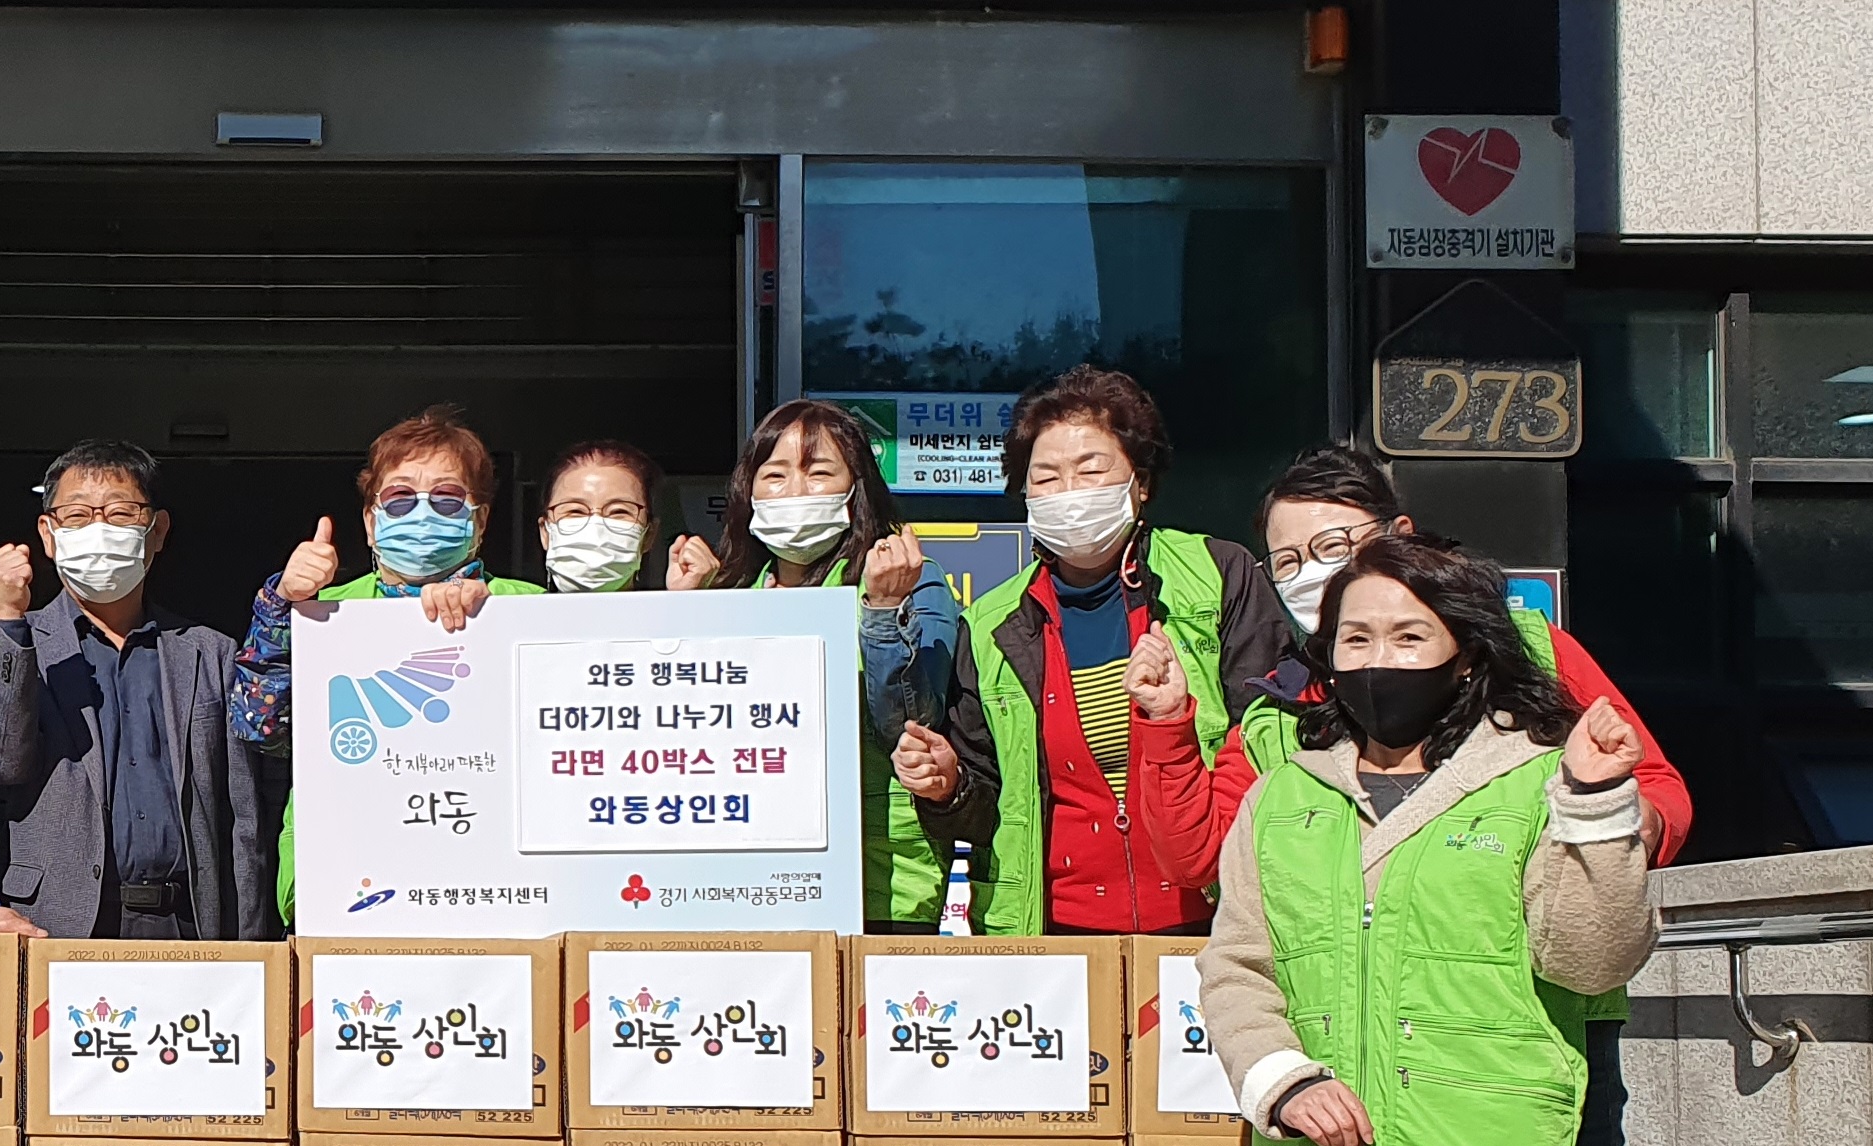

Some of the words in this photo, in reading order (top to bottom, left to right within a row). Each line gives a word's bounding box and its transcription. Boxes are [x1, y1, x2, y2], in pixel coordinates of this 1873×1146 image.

[1387, 227, 1491, 257] 자동심장충격기
[1495, 227, 1555, 257] 설치기관
[907, 402, 982, 427] 무더위
[1418, 369, 1571, 444] 273
[910, 433, 970, 450] 미세먼지
[933, 468, 963, 484] 031)
[587, 662, 635, 687] 와동
[650, 660, 749, 686] 행복나눔
[538, 705, 641, 731] 더하기와
[656, 703, 733, 729] 나누기
[749, 702, 801, 729] 행사
[382, 747, 401, 775] 한
[551, 749, 605, 776] 라면
[621, 748, 715, 775] 40박스
[732, 746, 787, 774] 전달
[402, 791, 478, 835] 와동
[588, 794, 750, 825] 와동상인회
[408, 887, 548, 905] 와동행정복지센터
[72, 1028, 137, 1072] 와동
[148, 1010, 239, 1064] 상인회
[336, 1022, 402, 1066] 와동
[413, 1004, 506, 1059] 상인회
[613, 1019, 680, 1063] 와동
[691, 1000, 786, 1056] 상인회
[890, 1022, 958, 1068] 와동
[969, 1004, 1062, 1060] 상인회
